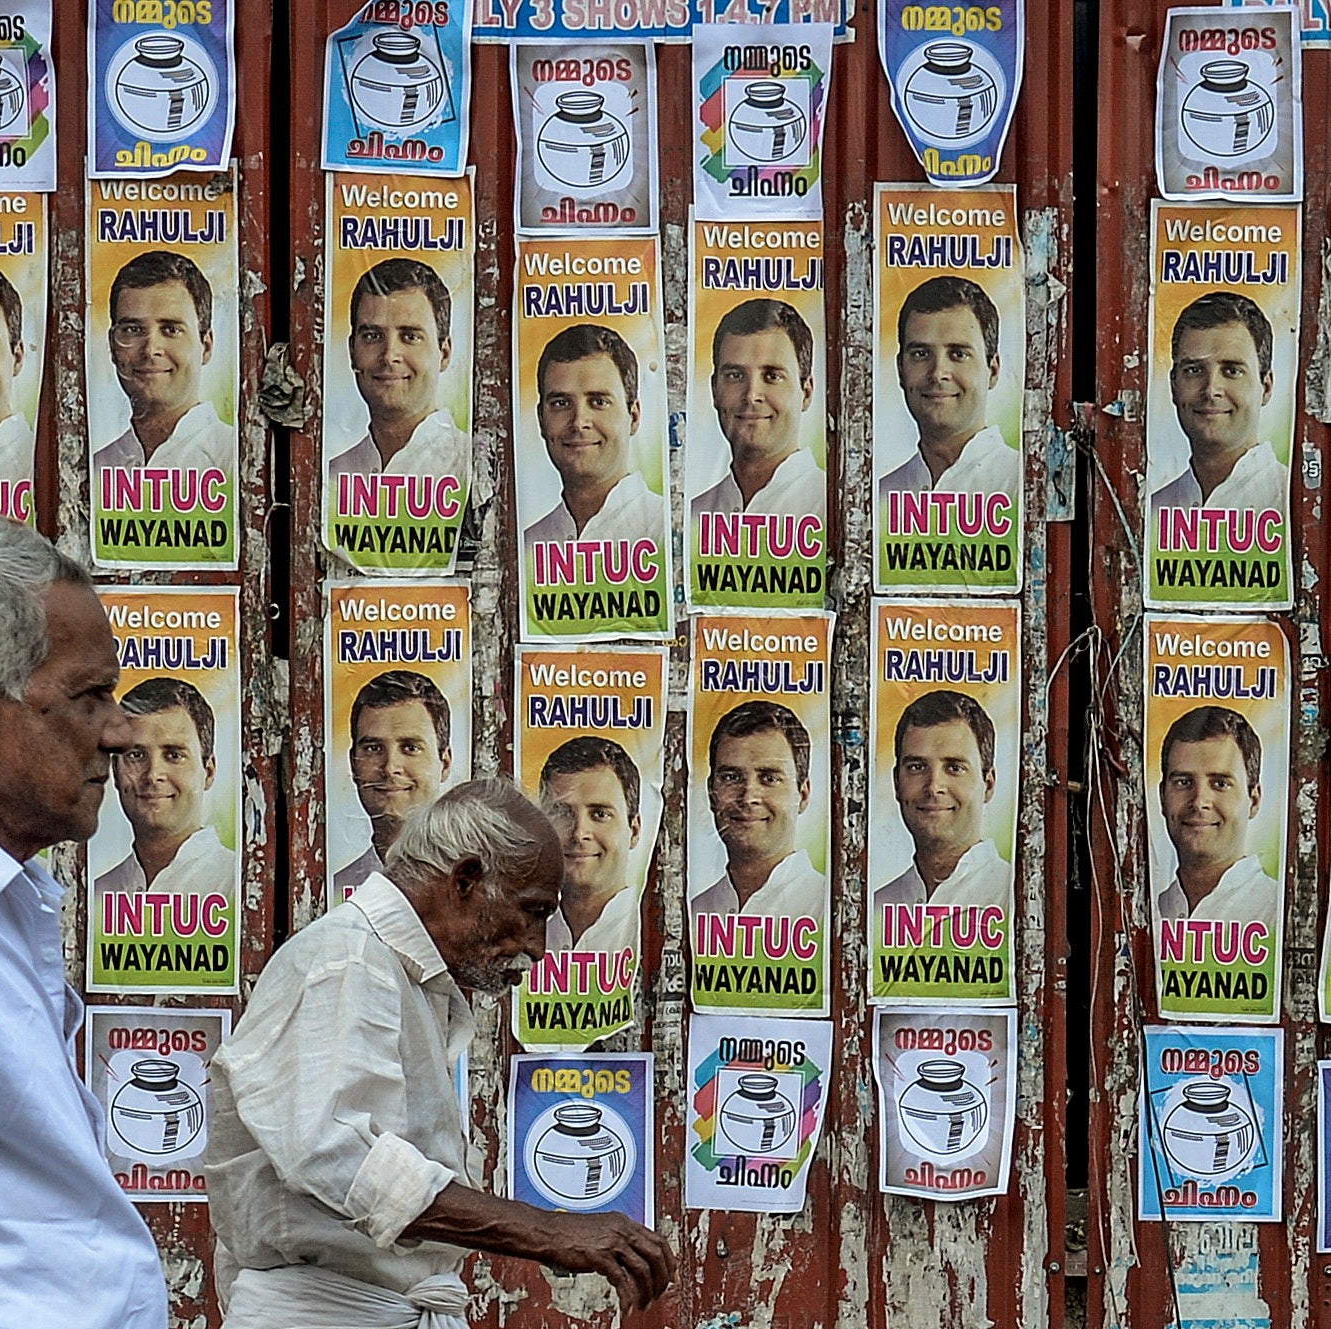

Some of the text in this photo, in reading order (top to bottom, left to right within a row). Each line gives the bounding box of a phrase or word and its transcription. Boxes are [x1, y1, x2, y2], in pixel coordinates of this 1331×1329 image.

[530, 0, 552, 29] 3
[563, 0, 689, 29] SHOWS
[1179, 25, 1276, 54] നമ്മുടെ
[723, 44, 812, 74] നമ്മുടെ
[727, 170, 807, 198] ചിഹ്നം
[1185, 171, 1280, 193] ചിഹ്നം
[342, 185, 459, 210] Welcome
[97, 210, 225, 242] RAHULJI
[888, 203, 1005, 227] Welcome
[340, 217, 464, 250] RAHULJI
[1165, 219, 1282, 244] Welcome
[525, 252, 642, 276] Welcome
[887, 236, 1011, 268] RAHULJI
[1162, 251, 1287, 284] RAHULJI
[524, 284, 649, 316] RAHULJI
[100, 467, 227, 509] INTUC
[338, 473, 459, 517] INTUC
[889, 492, 1011, 535] INTUC
[99, 518, 227, 547] WAYANAD
[1159, 509, 1283, 550] INTUC
[535, 541, 658, 584] INTUC
[886, 542, 1011, 571] WAYANAD
[1156, 558, 1281, 588] WAYANAD
[533, 591, 661, 622] WAYANAD
[887, 618, 1003, 644] Welcome
[1155, 633, 1271, 659] Welcome
[529, 663, 646, 689] Welcome
[886, 650, 1008, 684] RAHULJI
[1153, 665, 1276, 699] RAHULJI
[527, 695, 653, 728] RAHULJI
[102, 893, 228, 936] INTUC
[883, 906, 1004, 947] INTUC
[100, 942, 229, 972] WAYANAD
[880, 956, 1004, 984] WAYANAD
[718, 1037, 806, 1067] നമ്മുടെ
[894, 1027, 993, 1054] നമ്മുടെ
[717, 1160, 792, 1189] ചിഹ്നം
[904, 1165, 987, 1189] ചിഹ്നം
